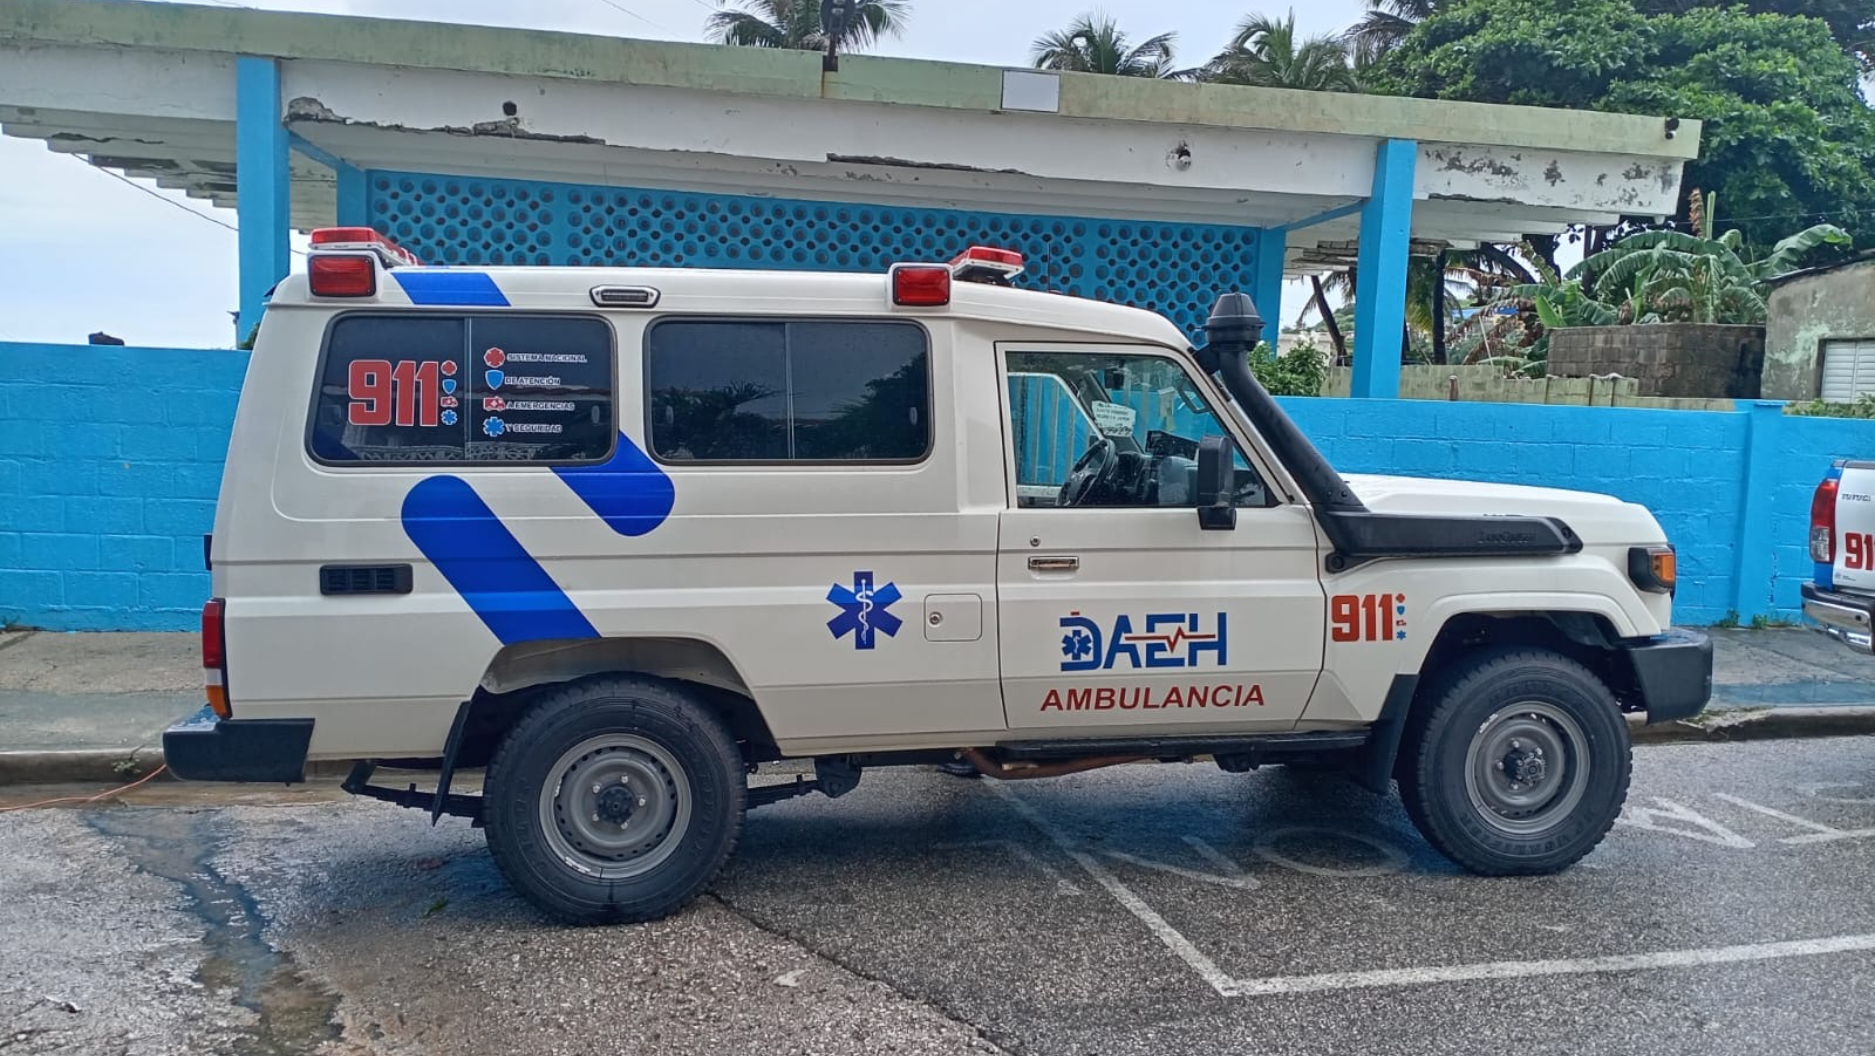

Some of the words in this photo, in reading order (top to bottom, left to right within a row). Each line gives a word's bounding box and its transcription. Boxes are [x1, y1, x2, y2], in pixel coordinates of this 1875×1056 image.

[507, 353, 544, 362] SISTEMA
[544, 354, 588, 363] NACIONAL
[348, 360, 439, 427] 911
[505, 376, 517, 385] DE
[517, 375, 561, 386] ATENCIÓN
[514, 402, 575, 411] EMERGENCIAS
[512, 424, 563, 433] SEGURIDAD
[1845, 532, 1875, 571] 91
[1332, 594, 1394, 643] 911
[1059, 611, 1228, 672] DAEH
[1040, 684, 1265, 712] AMBULANCIA
